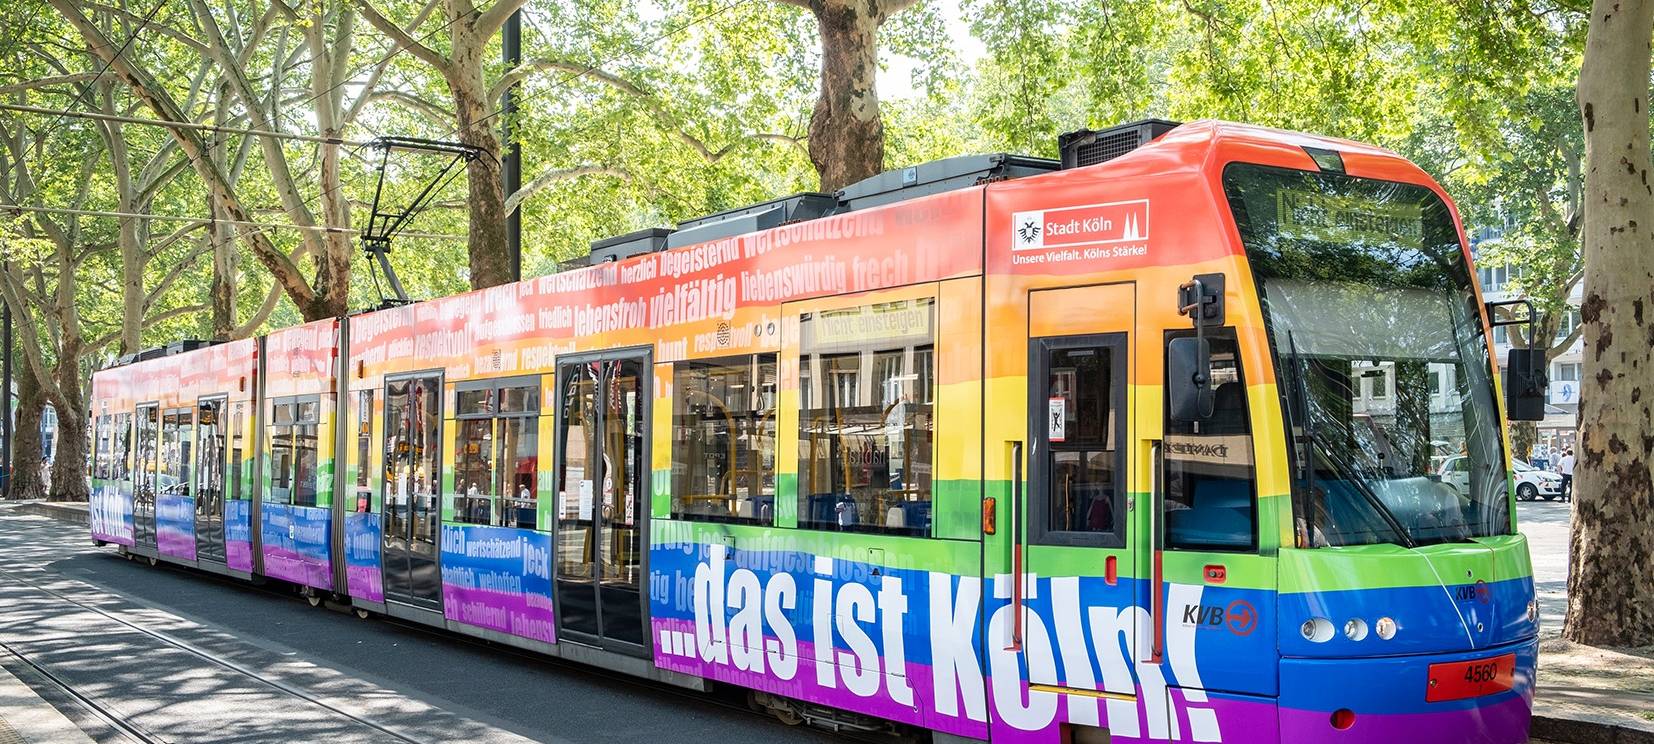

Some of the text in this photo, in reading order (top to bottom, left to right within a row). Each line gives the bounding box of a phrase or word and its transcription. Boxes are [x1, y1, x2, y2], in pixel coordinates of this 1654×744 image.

[1046, 216, 1112, 236] Stadt Köln
[1012, 244, 1147, 265] Unsere Vielfalt. Kölns Stärke!
[621, 256, 657, 285] herzlich
[414, 321, 472, 361] respektvoll
[539, 304, 573, 330] friedlich
[574, 296, 647, 337] lebensfroh
[649, 273, 737, 330] vielfältig
[741, 255, 847, 302] liebenswürdig
[852, 248, 909, 291] frech
[858, 306, 924, 334] einsteigen
[657, 336, 688, 362] bunt
[694, 322, 753, 353] resptvoll
[466, 536, 521, 560] wertschätzend
[522, 536, 549, 580] jeck
[1455, 585, 1478, 601] KVB
[1182, 604, 1224, 626] KVB
[813, 555, 915, 707] ist
[929, 571, 1222, 743] Köln!
[1464, 663, 1498, 682] 4560
